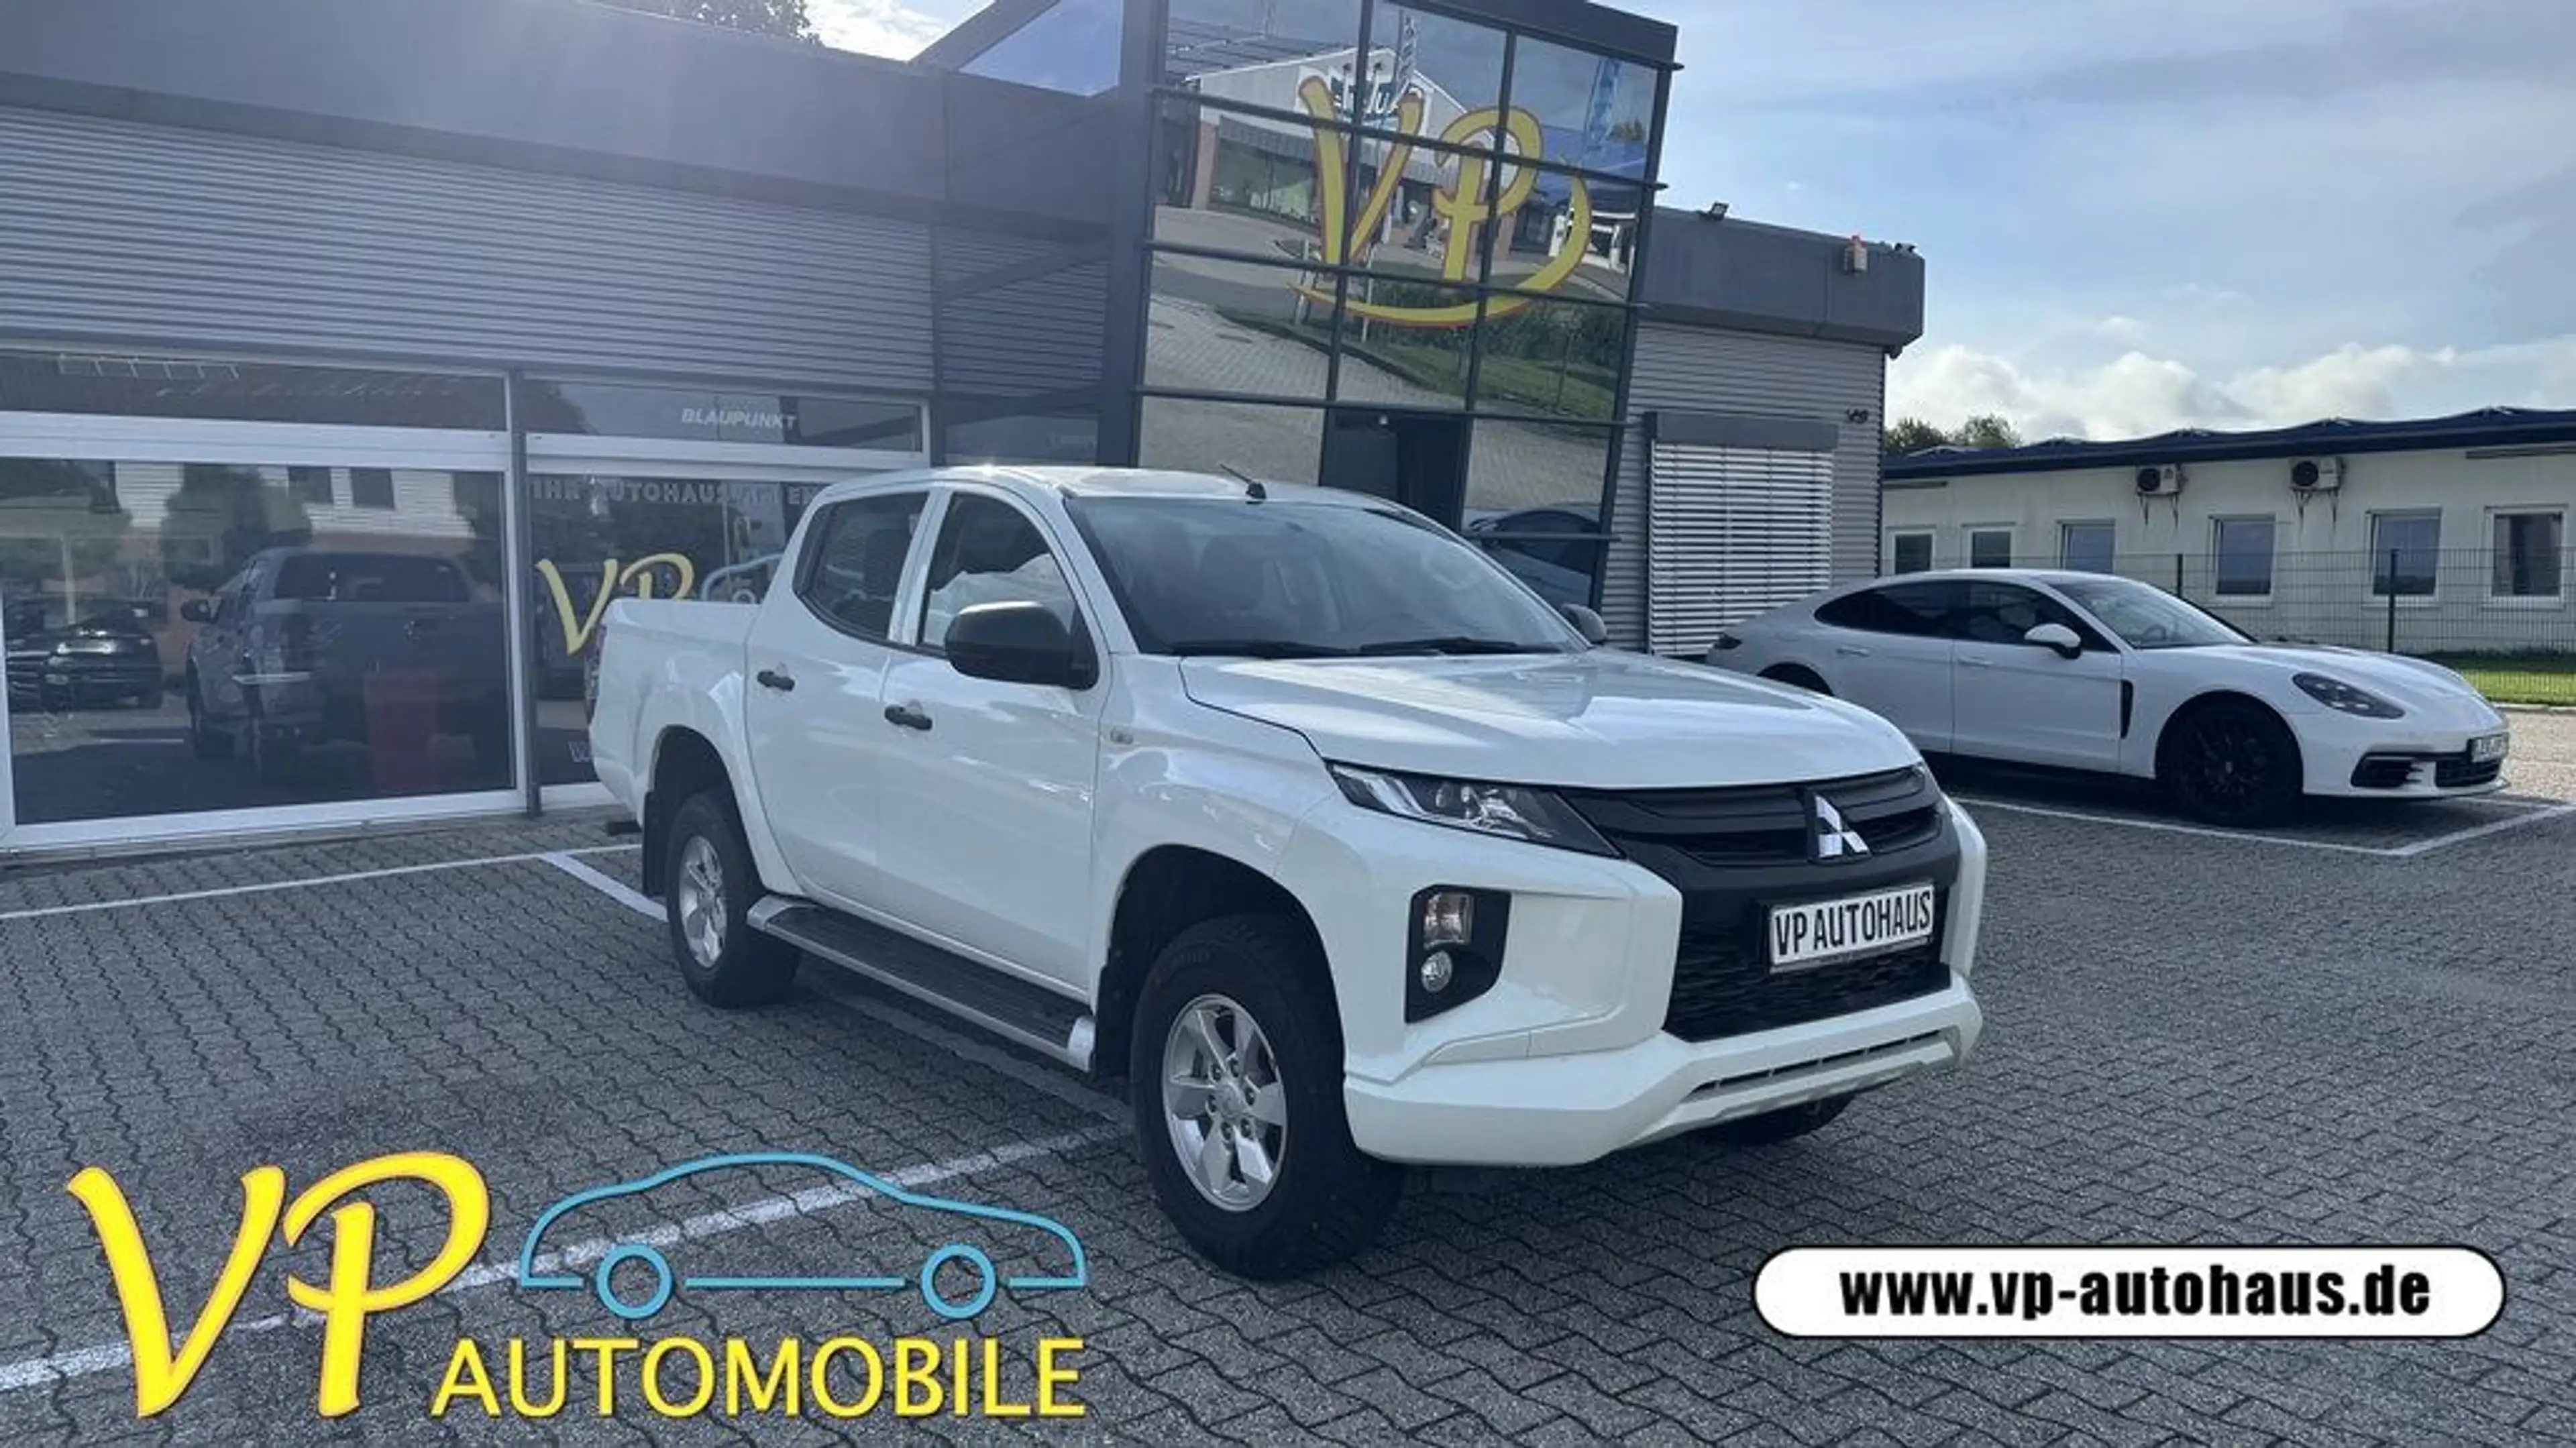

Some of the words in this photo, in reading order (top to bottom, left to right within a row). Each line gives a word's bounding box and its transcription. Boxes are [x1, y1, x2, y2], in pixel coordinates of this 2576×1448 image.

[1297, 74, 1543, 284] VP
[681, 407, 797, 431] BLAUPUNKT
[1774, 910, 1808, 956] VP
[1813, 889, 1931, 950] AUTOHAUS
